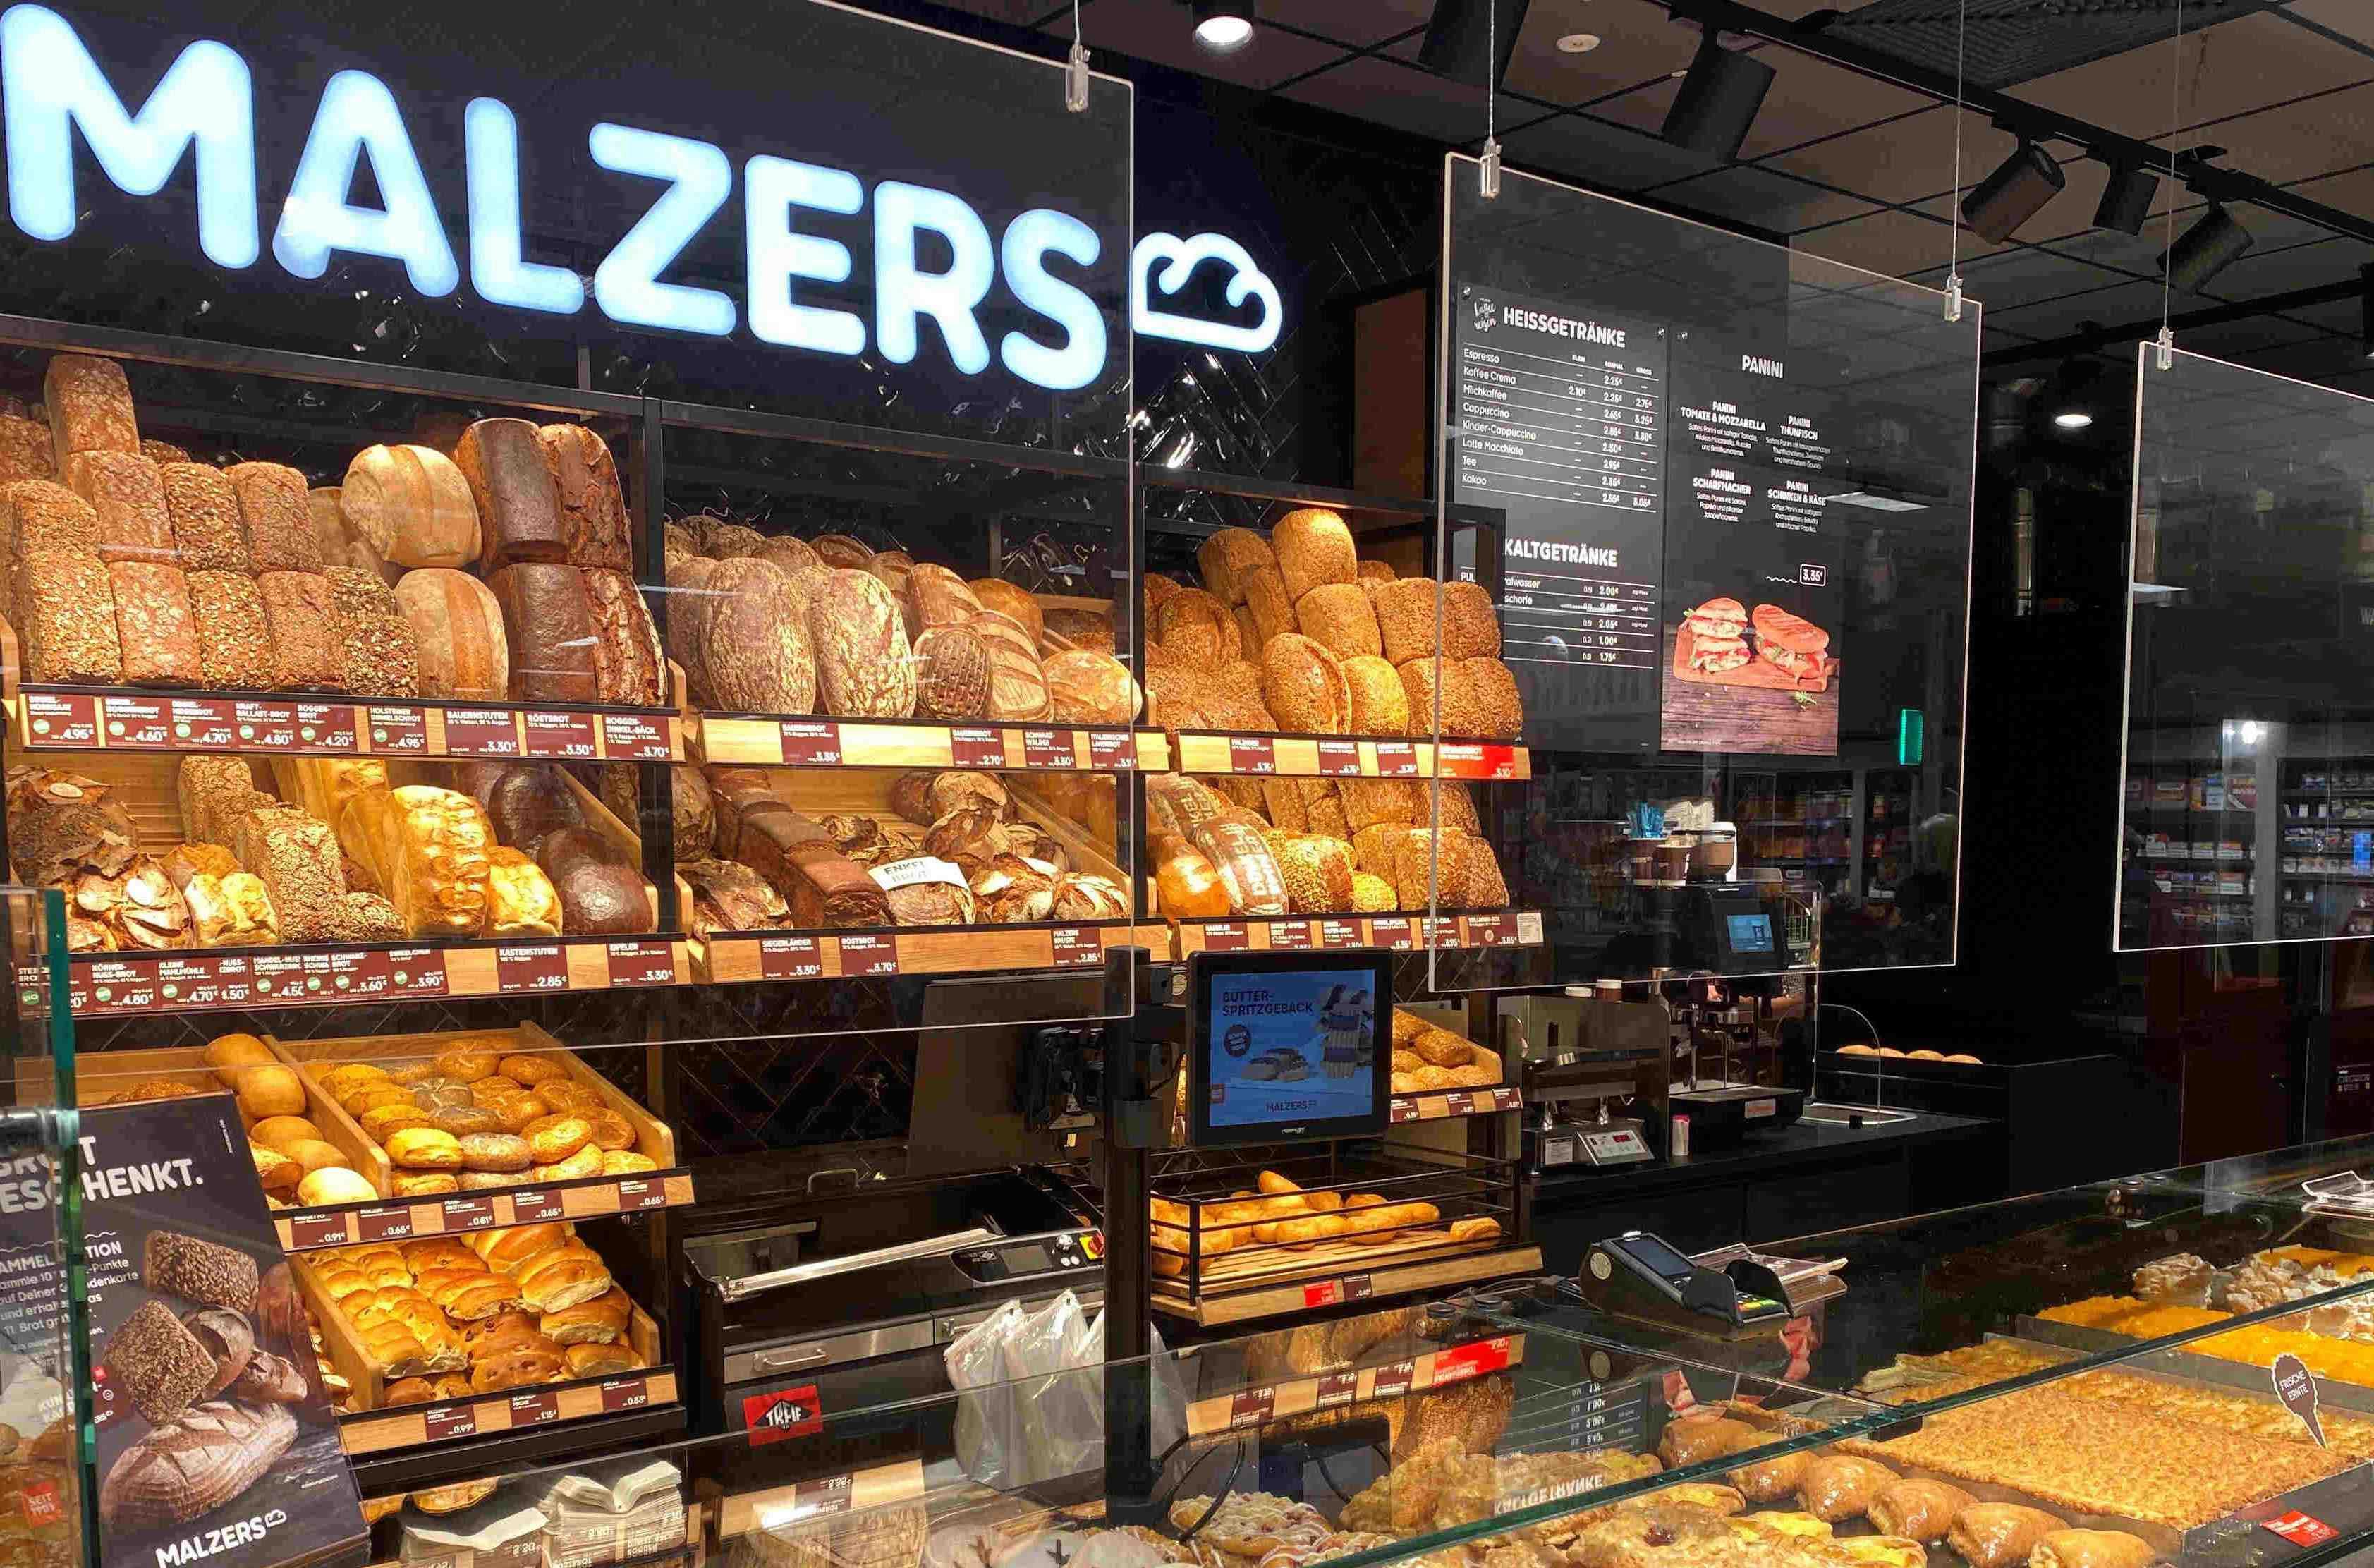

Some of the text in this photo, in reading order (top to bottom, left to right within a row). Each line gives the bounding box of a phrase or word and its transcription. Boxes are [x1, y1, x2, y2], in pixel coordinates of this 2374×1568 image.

[0, 6, 1107, 391] MALZERS
[1504, 307, 1626, 348] HEISSGETRÄNKE
[1463, 348, 1500, 364] Espresso
[1741, 355, 1784, 379] PANINI
[1463, 366, 1489, 380] Kaffee
[1490, 371, 1516, 384] Crema
[1463, 384, 1507, 401] Milchkaffee
[1463, 402, 1510, 418] Cappuccino
[1712, 401, 1736, 414] PANINI
[1681, 407, 1711, 422] TOMATE
[1718, 414, 1767, 431] MOZZARELLA
[1788, 415, 1810, 428] PANINI
[1462, 420, 1536, 441] Kinder-Cappuccino
[1780, 425, 1818, 440] THUNFISCH
[1462, 439, 1483, 450] Latte
[1484, 442, 1524, 456] Macchiato
[1462, 456, 1477, 467] Tee
[1461, 473, 1487, 487] Kakao
[1710, 468, 1735, 481] PANINI
[1693, 477, 1752, 495] SCHARFMACHER
[1786, 480, 1809, 492] PANINI
[1767, 488, 1802, 503] SCHINKEN
[1504, 538, 1619, 567] KALTGETRÄNKE
[446, 710, 509, 720] BAUERNSTUTEN
[528, 714, 569, 723] RÖSTBROT
[264, 734, 293, 746] 4.80€
[324, 736, 354, 746] 4.20€
[643, 746, 670, 758] 3.70€
[537, 976, 567, 987] 2.85€
[1222, 990, 1274, 1003] BUTTER-
[1222, 1002, 1313, 1016] SPRITZGEBÄCK
[1266, 1100, 1310, 1112] MALZERS
[18, 1287, 56, 1303] Deiner
[155, 1516, 267, 1568] MALZERS
